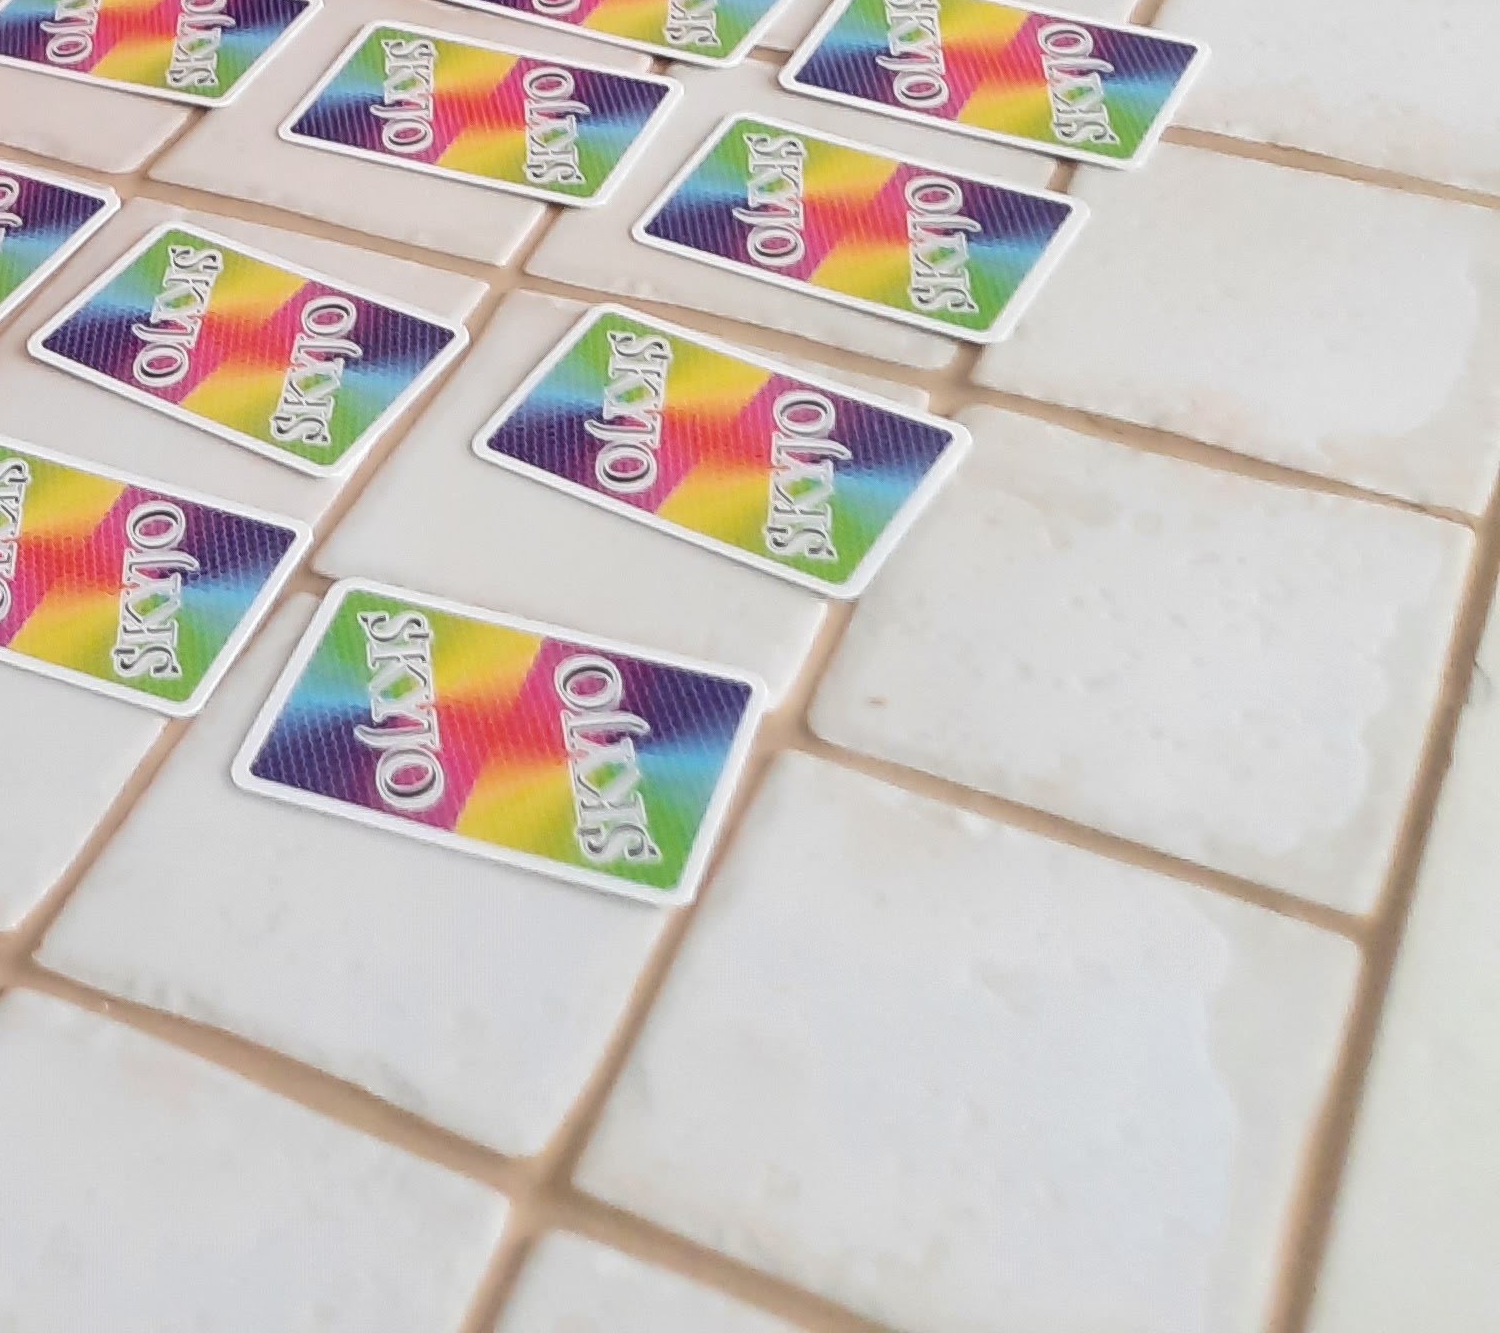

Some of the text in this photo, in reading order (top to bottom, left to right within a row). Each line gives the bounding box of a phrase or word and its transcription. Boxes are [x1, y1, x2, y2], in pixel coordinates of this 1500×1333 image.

[370, 39, 437, 154] SKYJO
[523, 67, 592, 184] SKYJO
[1037, 22, 1119, 146] SKYJO
[732, 133, 806, 267] SKYJO
[905, 176, 981, 313] SKYJO
[131, 245, 223, 387] SKYJO
[270, 296, 363, 445] SKYJO
[584, 331, 673, 493] SKYJO
[765, 390, 853, 562] SKYJO
[113, 501, 199, 679] SKYJO
[354, 610, 445, 811] SKYJO
[554, 656, 662, 864] SKYJO
